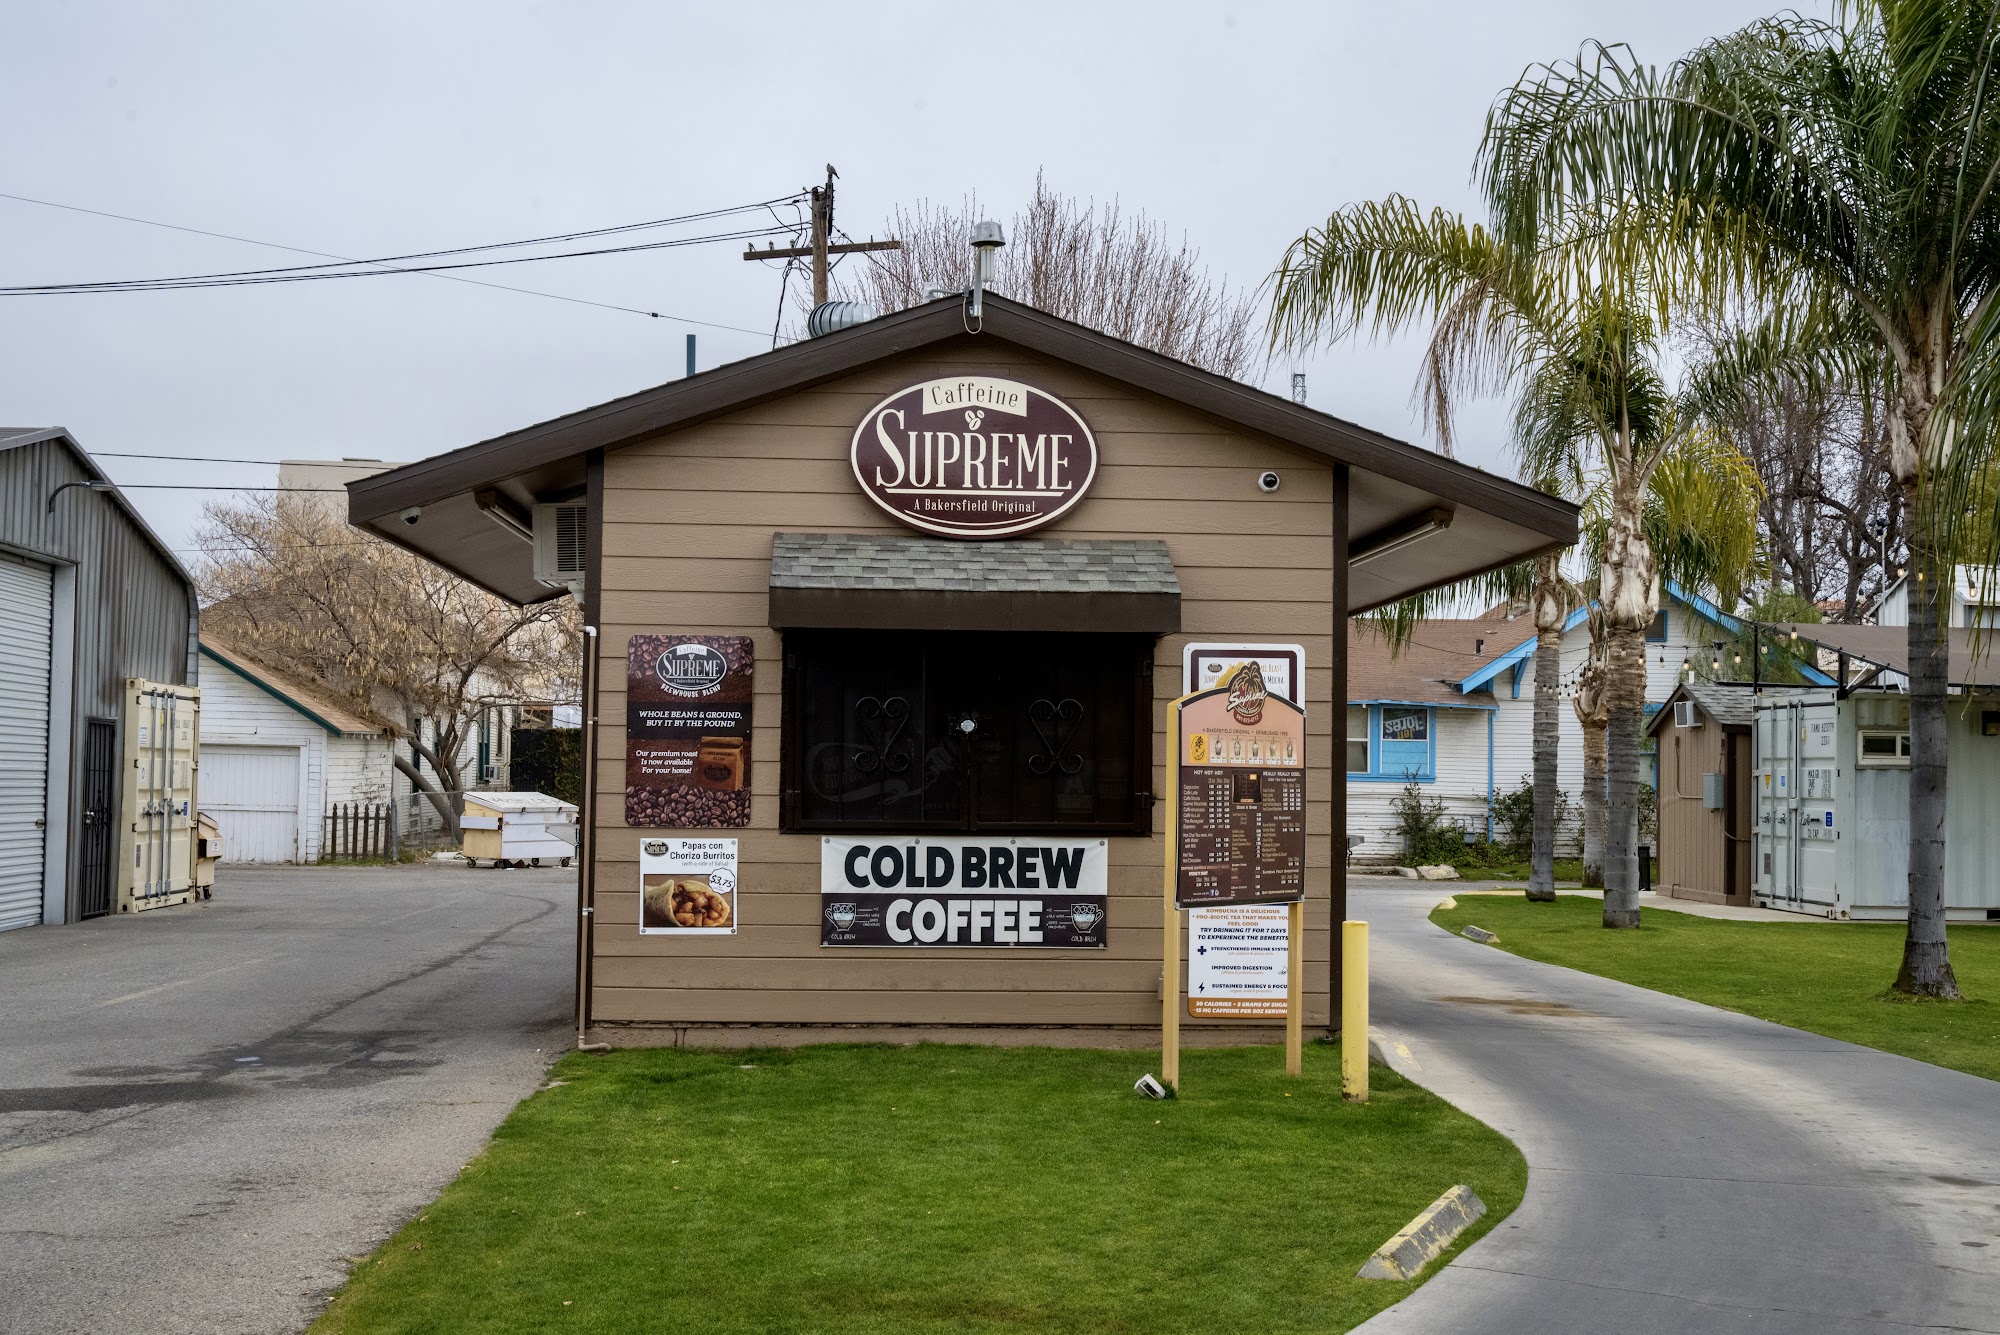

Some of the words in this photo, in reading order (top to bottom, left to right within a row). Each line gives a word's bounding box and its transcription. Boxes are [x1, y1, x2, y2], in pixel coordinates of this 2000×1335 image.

[931, 382, 1019, 408] Caffeine
[876, 408, 1073, 490] SUPREME
[914, 499, 921, 511] A
[924, 498, 988, 513] Bakersfield
[992, 500, 1036, 515] Original
[663, 653, 720, 677] SUPREME
[660, 683, 699, 698] BREWHOUSE
[702, 683, 721, 697] BLEND
[703, 720, 736, 728] POUND!
[1384, 714, 1425, 734] Flores
[650, 750, 681, 758] premium
[682, 841, 707, 851] Papas
[670, 851, 701, 860] Chorizo
[703, 851, 735, 860] Burritos
[844, 845, 955, 889] COLD
[961, 846, 1086, 889] BREW
[711, 874, 734, 888] $3.75
[885, 898, 1043, 943] COFFEE
